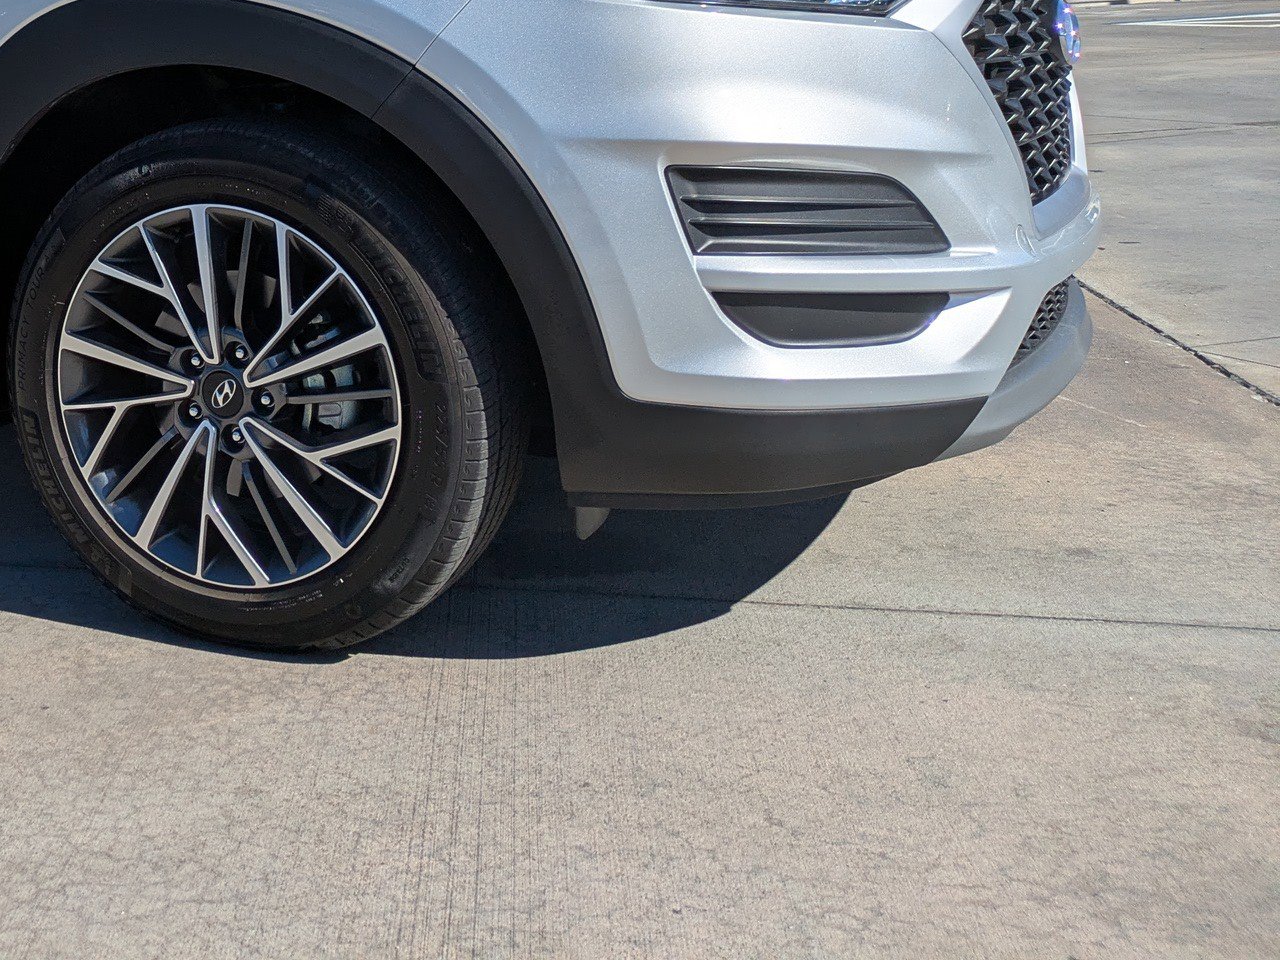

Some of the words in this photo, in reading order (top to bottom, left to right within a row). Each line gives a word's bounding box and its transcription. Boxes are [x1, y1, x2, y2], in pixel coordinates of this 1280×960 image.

[18, 315, 31, 391] PRIMACY
[26, 266, 45, 309] TOUR
[21, 413, 88, 543] MICHELIN
